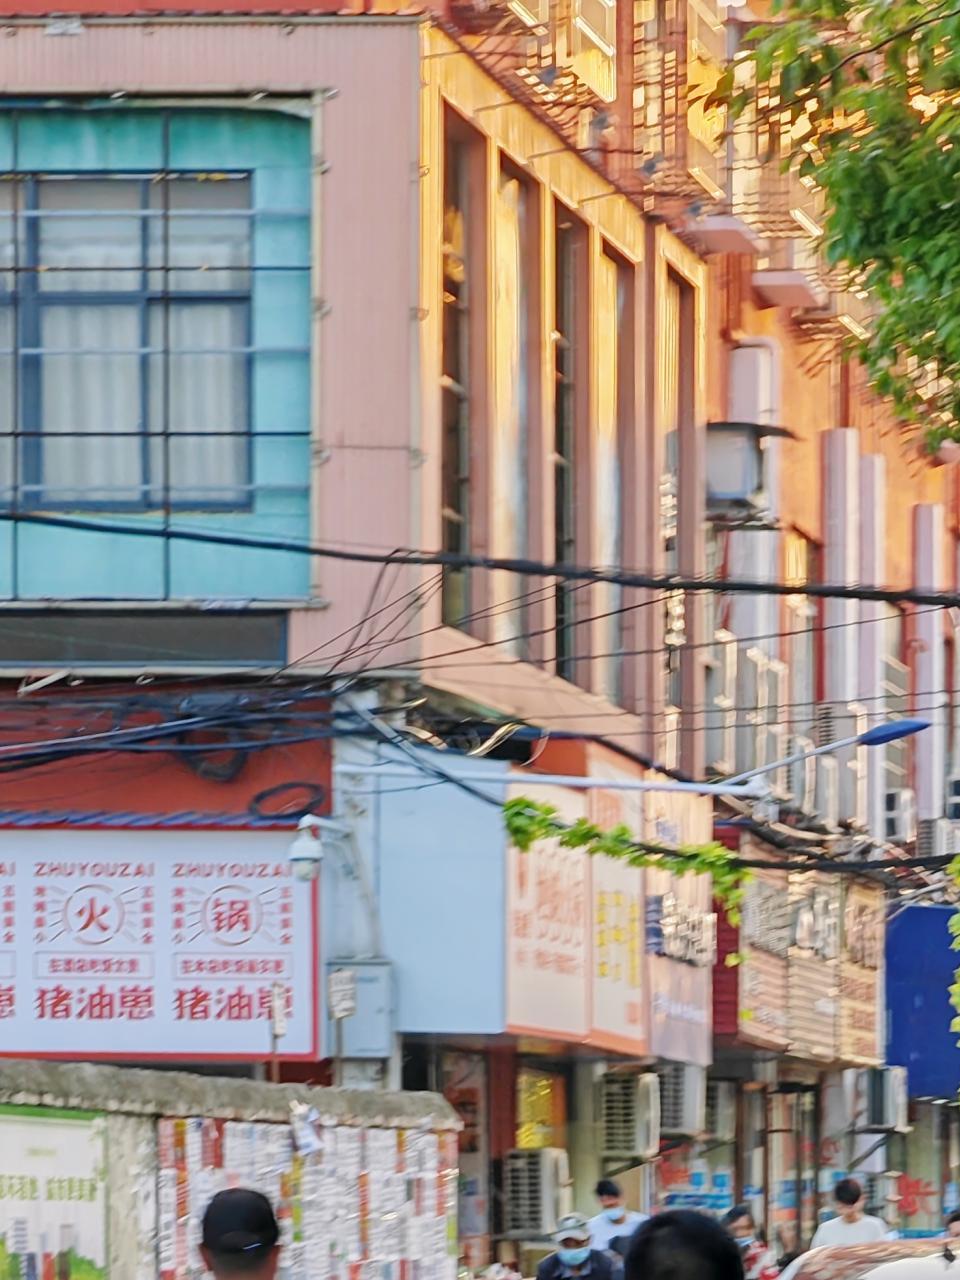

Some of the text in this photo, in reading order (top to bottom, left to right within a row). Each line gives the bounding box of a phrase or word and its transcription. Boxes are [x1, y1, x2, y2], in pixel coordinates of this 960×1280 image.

[33, 862, 155, 877] ZHUYOUZAI
[172, 863, 293, 877] ZHUYOUZAI
[76, 897, 110, 932] 火
[212, 898, 250, 932] 锅
[34, 984, 155, 1020] 猪油崽
